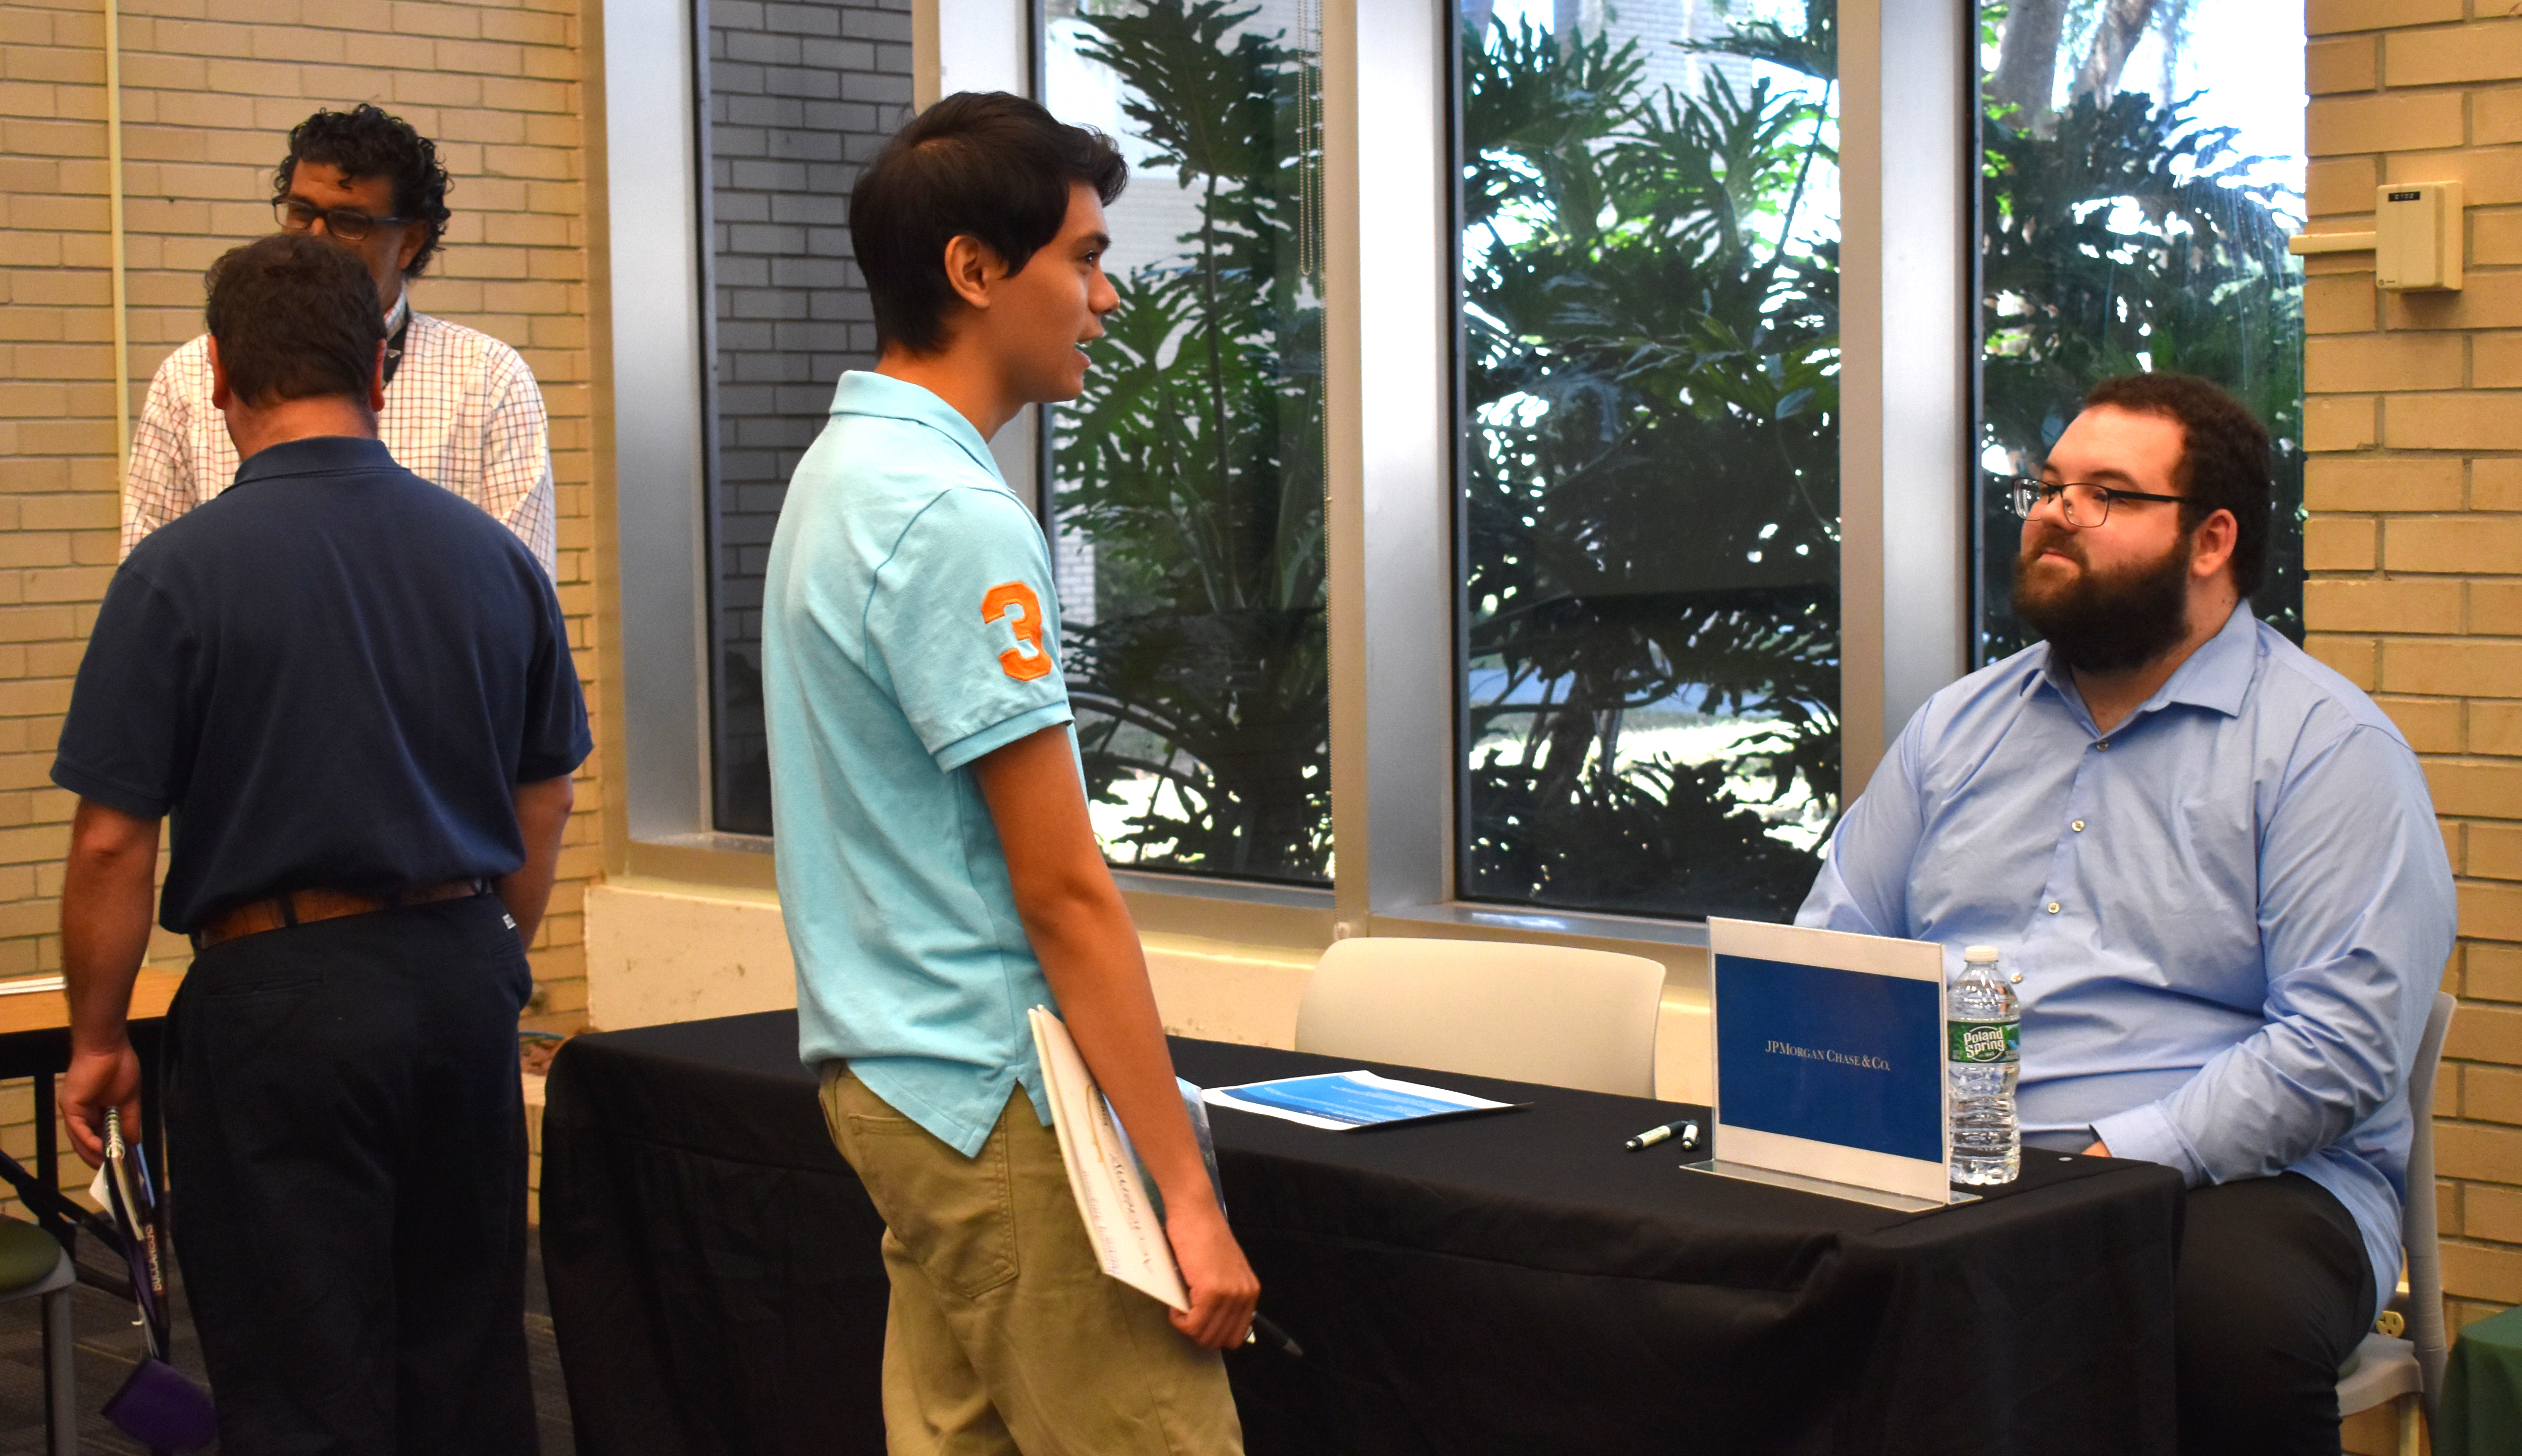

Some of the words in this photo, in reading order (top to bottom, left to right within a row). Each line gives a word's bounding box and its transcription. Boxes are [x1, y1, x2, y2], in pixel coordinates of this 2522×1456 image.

[981, 580, 1052, 681] 3
[1963, 1027, 2004, 1045] Poland
[1965, 1039, 2005, 1058] Spring
